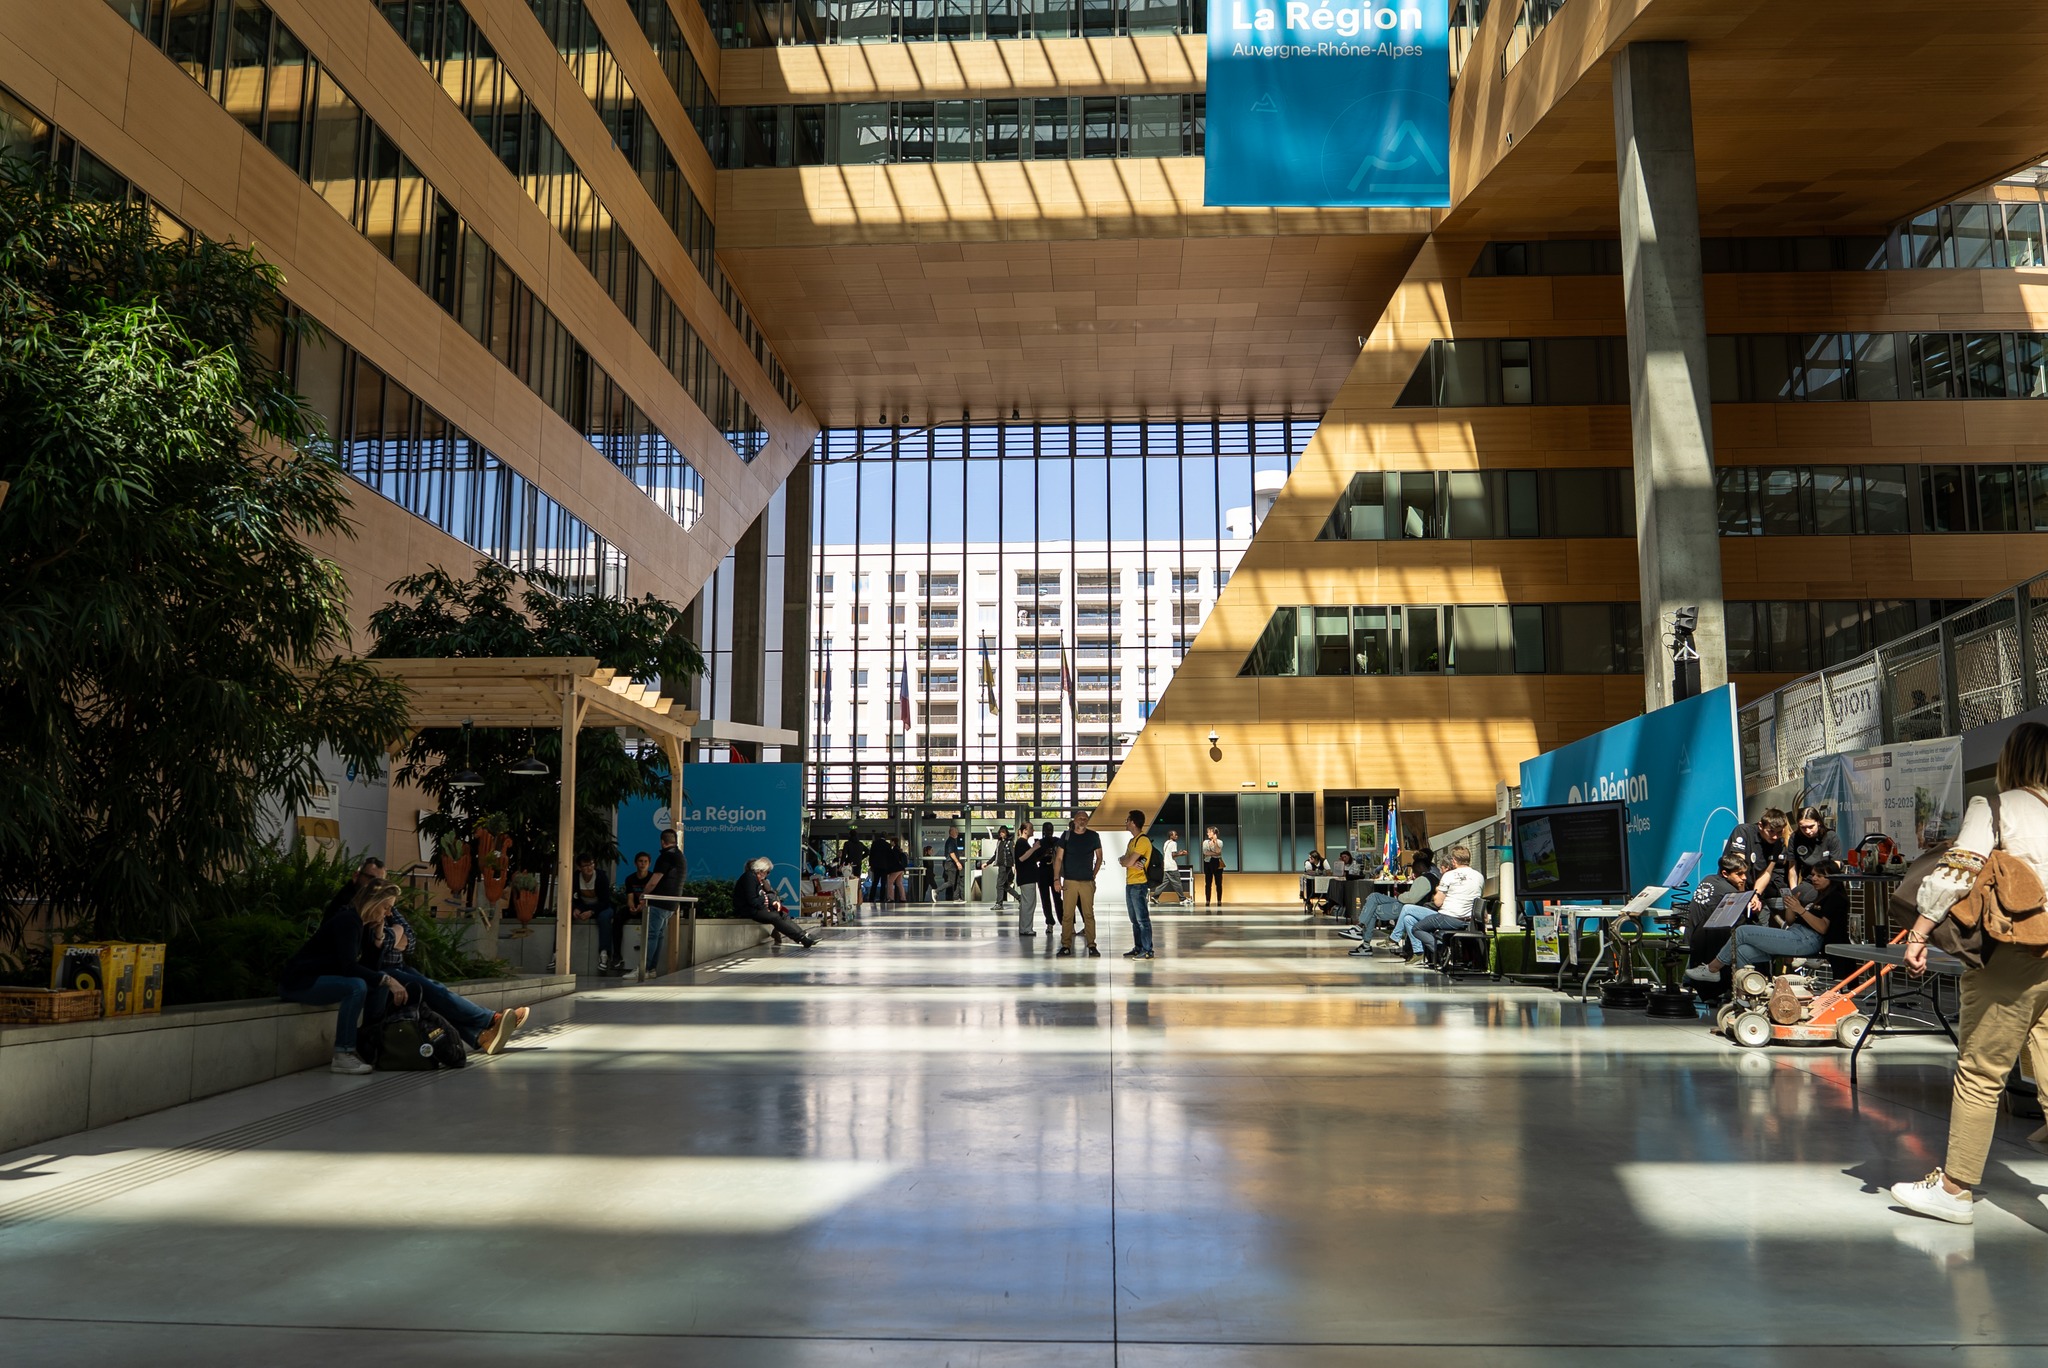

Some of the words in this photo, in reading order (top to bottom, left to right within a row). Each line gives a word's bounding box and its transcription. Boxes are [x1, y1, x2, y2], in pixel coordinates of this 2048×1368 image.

[1232, 2, 1275, 31] La
[1286, 0, 1422, 37] Région
[1232, 42, 1423, 60] Auvergne-Rhône-Alpes
[1882, 796, 1914, 809] 925-2025
[682, 806, 701, 820] La
[706, 805, 766, 823] Région
